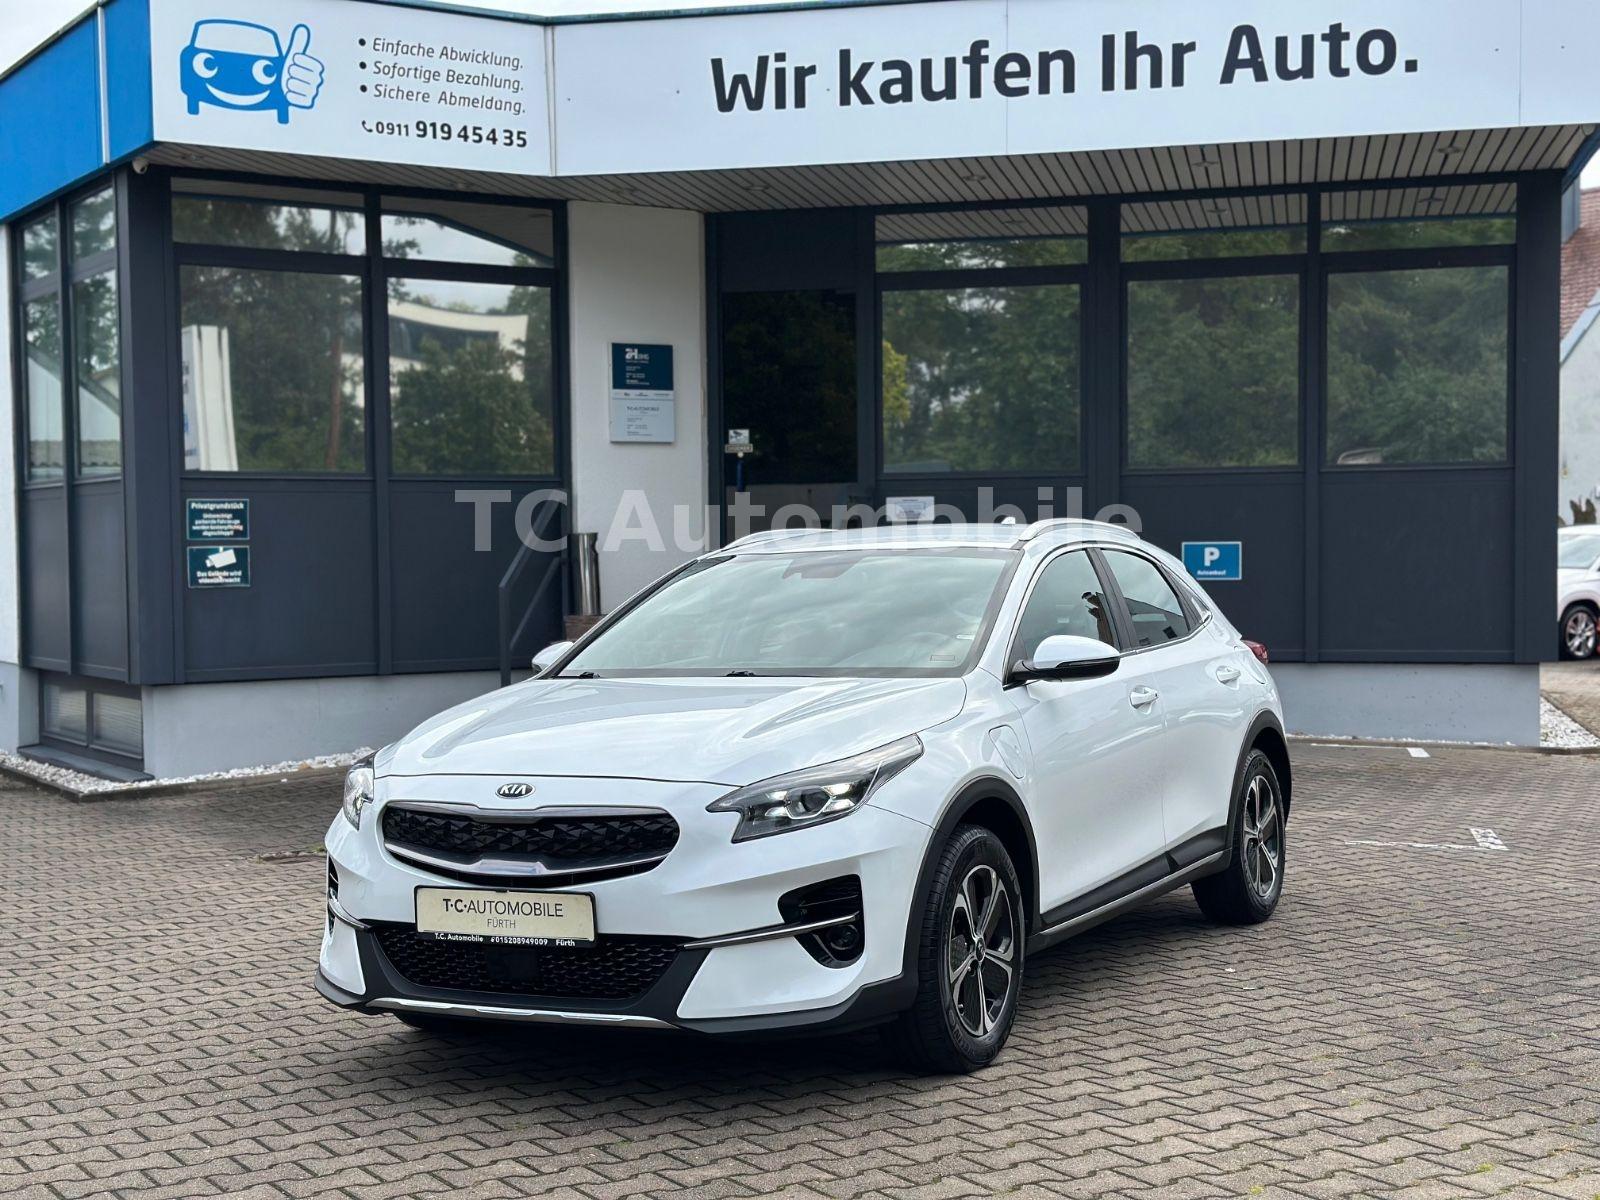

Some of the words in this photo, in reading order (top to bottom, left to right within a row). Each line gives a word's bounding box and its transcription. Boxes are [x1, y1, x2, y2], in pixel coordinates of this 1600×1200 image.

[372, 37, 435, 58] Einfache
[439, 46, 524, 71] Abwicklung.
[711, 52, 817, 113] Wir
[838, 39, 1077, 107] kaufen
[1102, 30, 1197, 92] Ihr
[1219, 22, 1420, 85] Auto.
[373, 61, 441, 83] Sofortige
[446, 69, 524, 93] Bezahlung.
[373, 83, 430, 103] Sichere
[437, 91, 526, 116] Abmeldung.
[375, 121, 410, 137] 0911
[192, 502, 244, 510] Privatgrundstück
[1204, 546, 1220, 566] P
[499, 784, 527, 795] KIA
[487, 918, 516, 929] FÜRTH
[447, 933, 484, 943] Automobile
[555, 939, 576, 947] Fürth
